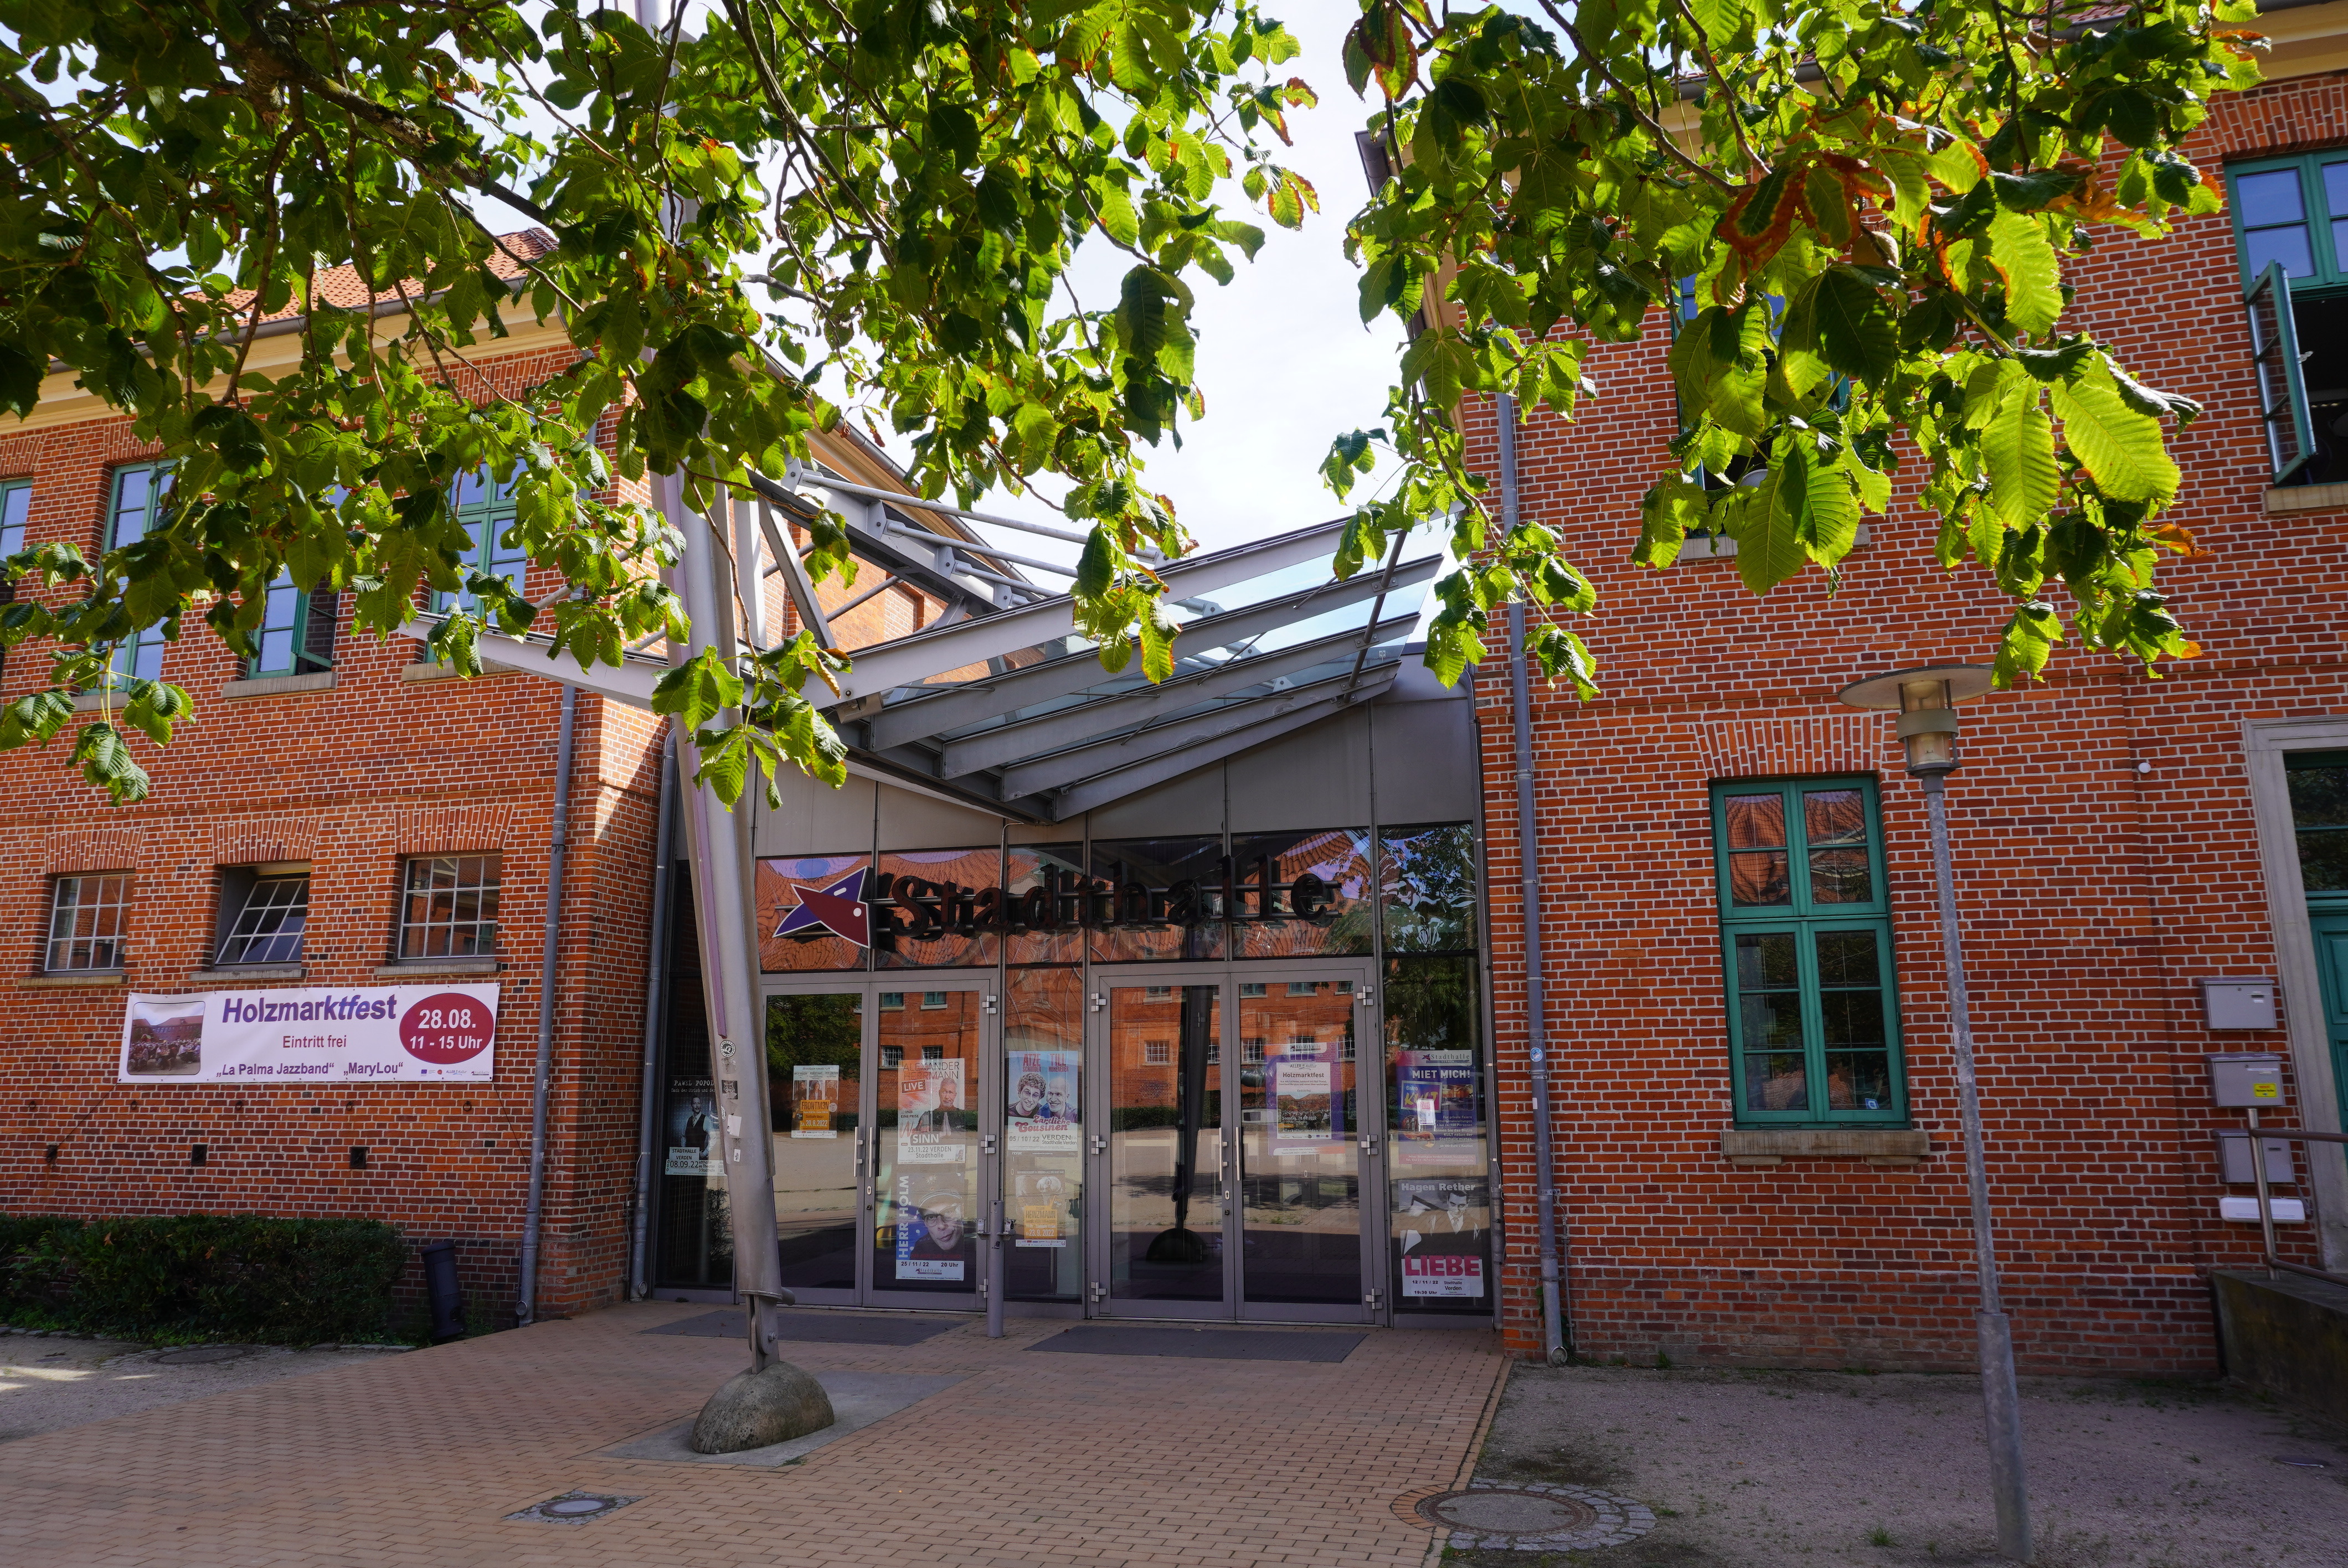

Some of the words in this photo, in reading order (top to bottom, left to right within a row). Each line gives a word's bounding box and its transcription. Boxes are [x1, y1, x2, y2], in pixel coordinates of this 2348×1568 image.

[890, 853, 1327, 937] Stadthalle
[222, 994, 397, 1023] Holzmarktfest
[418, 1009, 476, 1029] 28.08.
[282, 1035, 324, 1048] Eintritt
[327, 1035, 347, 1048] frei
[410, 1035, 424, 1049] 11
[439, 1035, 454, 1049] 15
[458, 1035, 483, 1049] Uhr
[1023, 1053, 1041, 1066] ATZE
[1049, 1053, 1067, 1066] TILL
[239, 1063, 273, 1075] Palma
[903, 1061, 960, 1071] ALEXANDER
[904, 1071, 959, 1080] HERRMANN
[1412, 1070, 1437, 1079] MIET
[1440, 1070, 1470, 1079] MICH!
[904, 1081, 924, 1091] LIVE
[801, 1101, 828, 1110] FRONTM3N
[1033, 1115, 1070, 1126] Zärtliche
[912, 1133, 939, 1144] SINN
[1401, 1183, 1435, 1193] Hagen
[1439, 1183, 1475, 1191] Rether
[899, 1175, 909, 1217] HOLM
[1026, 1210, 1055, 1219] HEINZMANN
[898, 1223, 909, 1258] HERR
[1404, 1255, 1480, 1276] LIEBE
